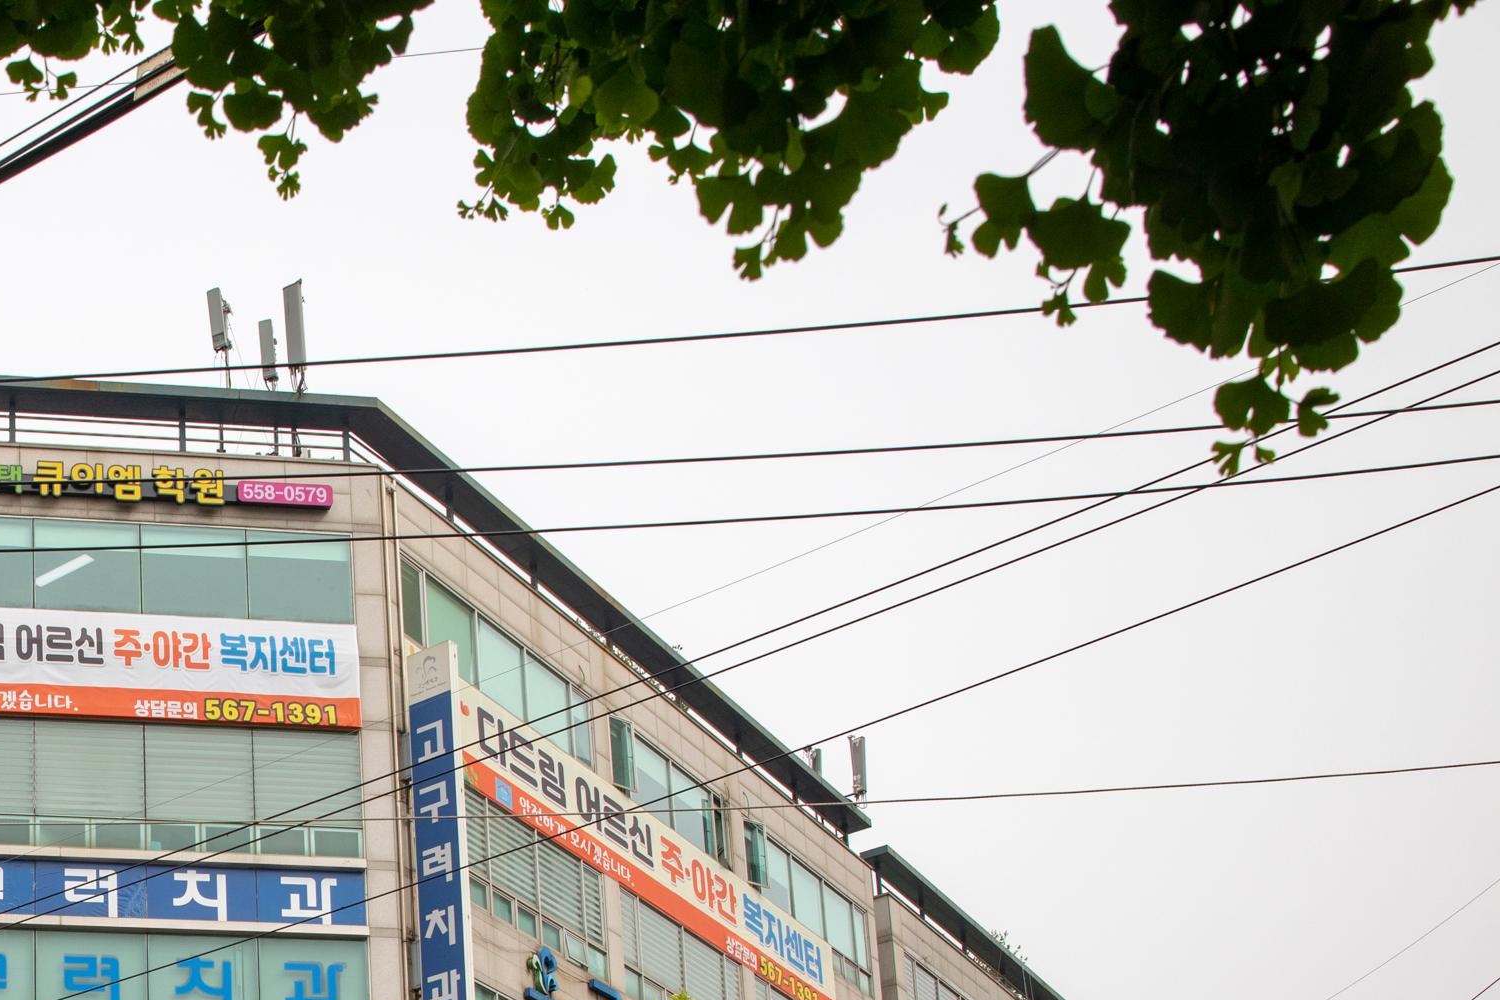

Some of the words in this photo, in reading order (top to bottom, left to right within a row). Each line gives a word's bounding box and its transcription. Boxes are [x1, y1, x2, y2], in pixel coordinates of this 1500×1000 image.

[33, 460, 142, 501] 큐이엠
[153, 466, 224, 505] 학원
[242, 482, 327, 506] 558-0579
[16, 624, 104, 665] 어르신
[114, 629, 210, 672] 주·야간
[219, 633, 337, 677] 복지센터
[134, 698, 198, 720] 상담문의
[204, 699, 337, 725] 567-1391
[477, 705, 567, 810] 다드림
[576, 776, 654, 869] 어르신
[743, 892, 823, 986] 복지센터
[519, 796, 568, 841] 안전하게
[570, 832, 635, 888] 모시겠습니다.
[725, 935, 757, 971] 상담문의
